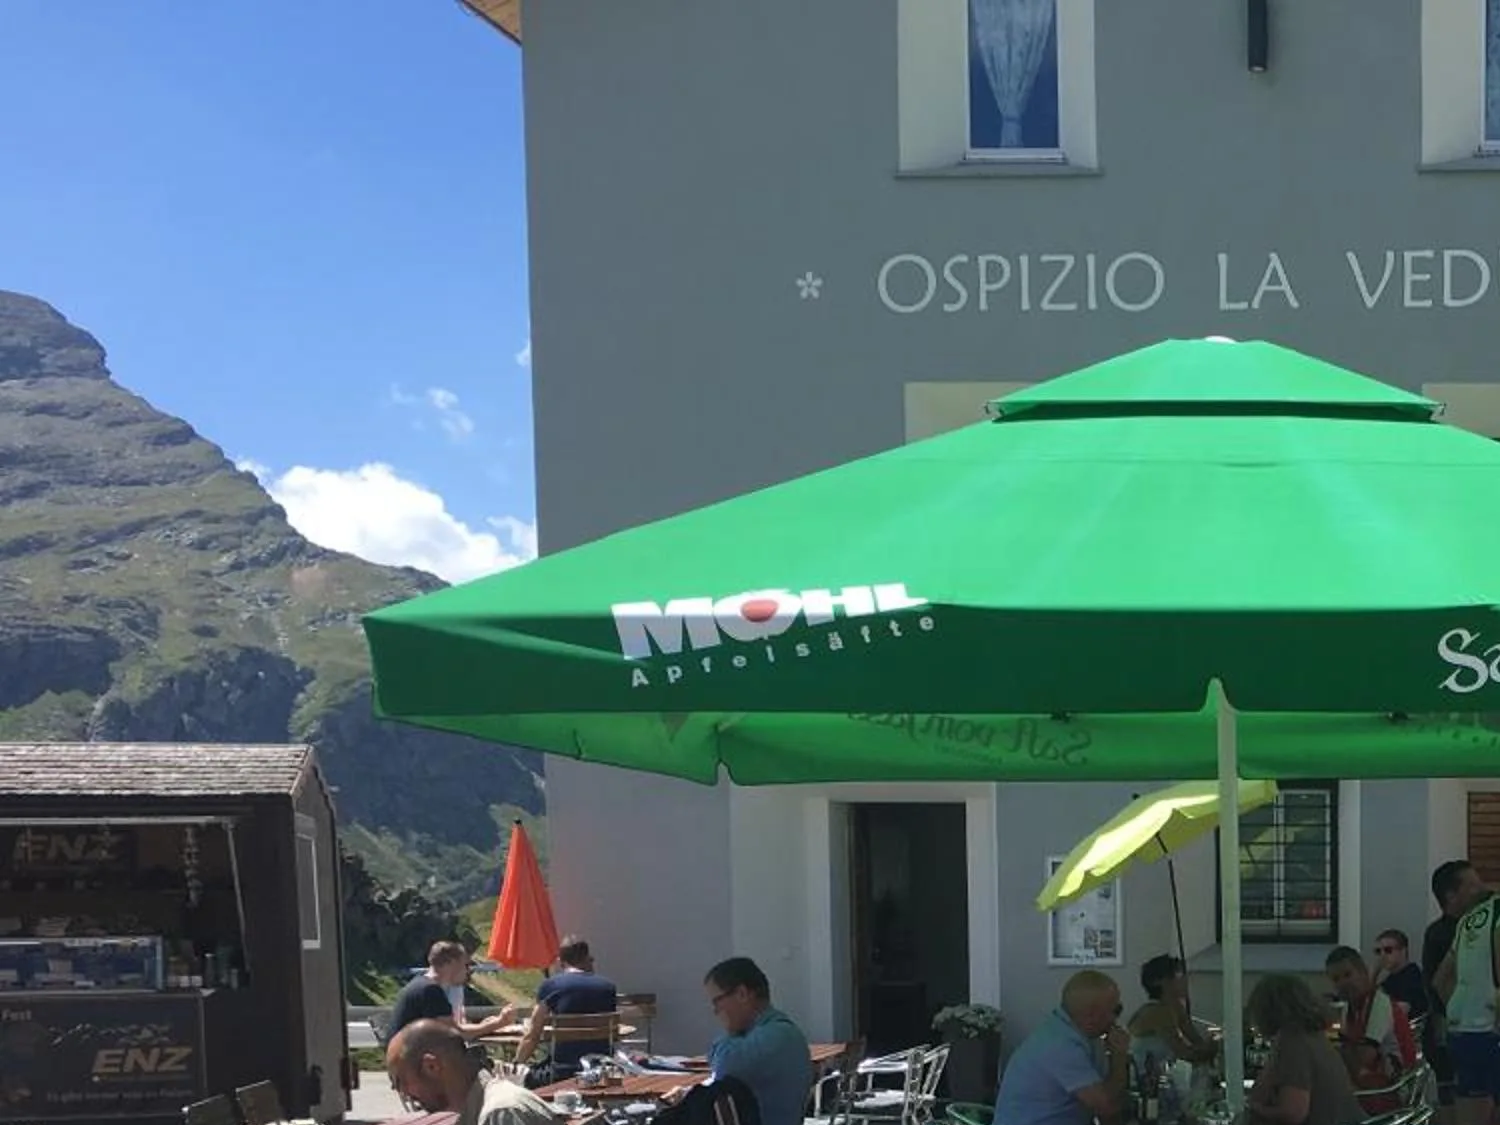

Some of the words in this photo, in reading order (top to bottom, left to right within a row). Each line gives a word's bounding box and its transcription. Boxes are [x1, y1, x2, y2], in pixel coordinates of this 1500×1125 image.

[877, 252, 1165, 313] OSPIZIO
[1217, 252, 1299, 310] LA
[91, 1047, 193, 1073] ENZ
